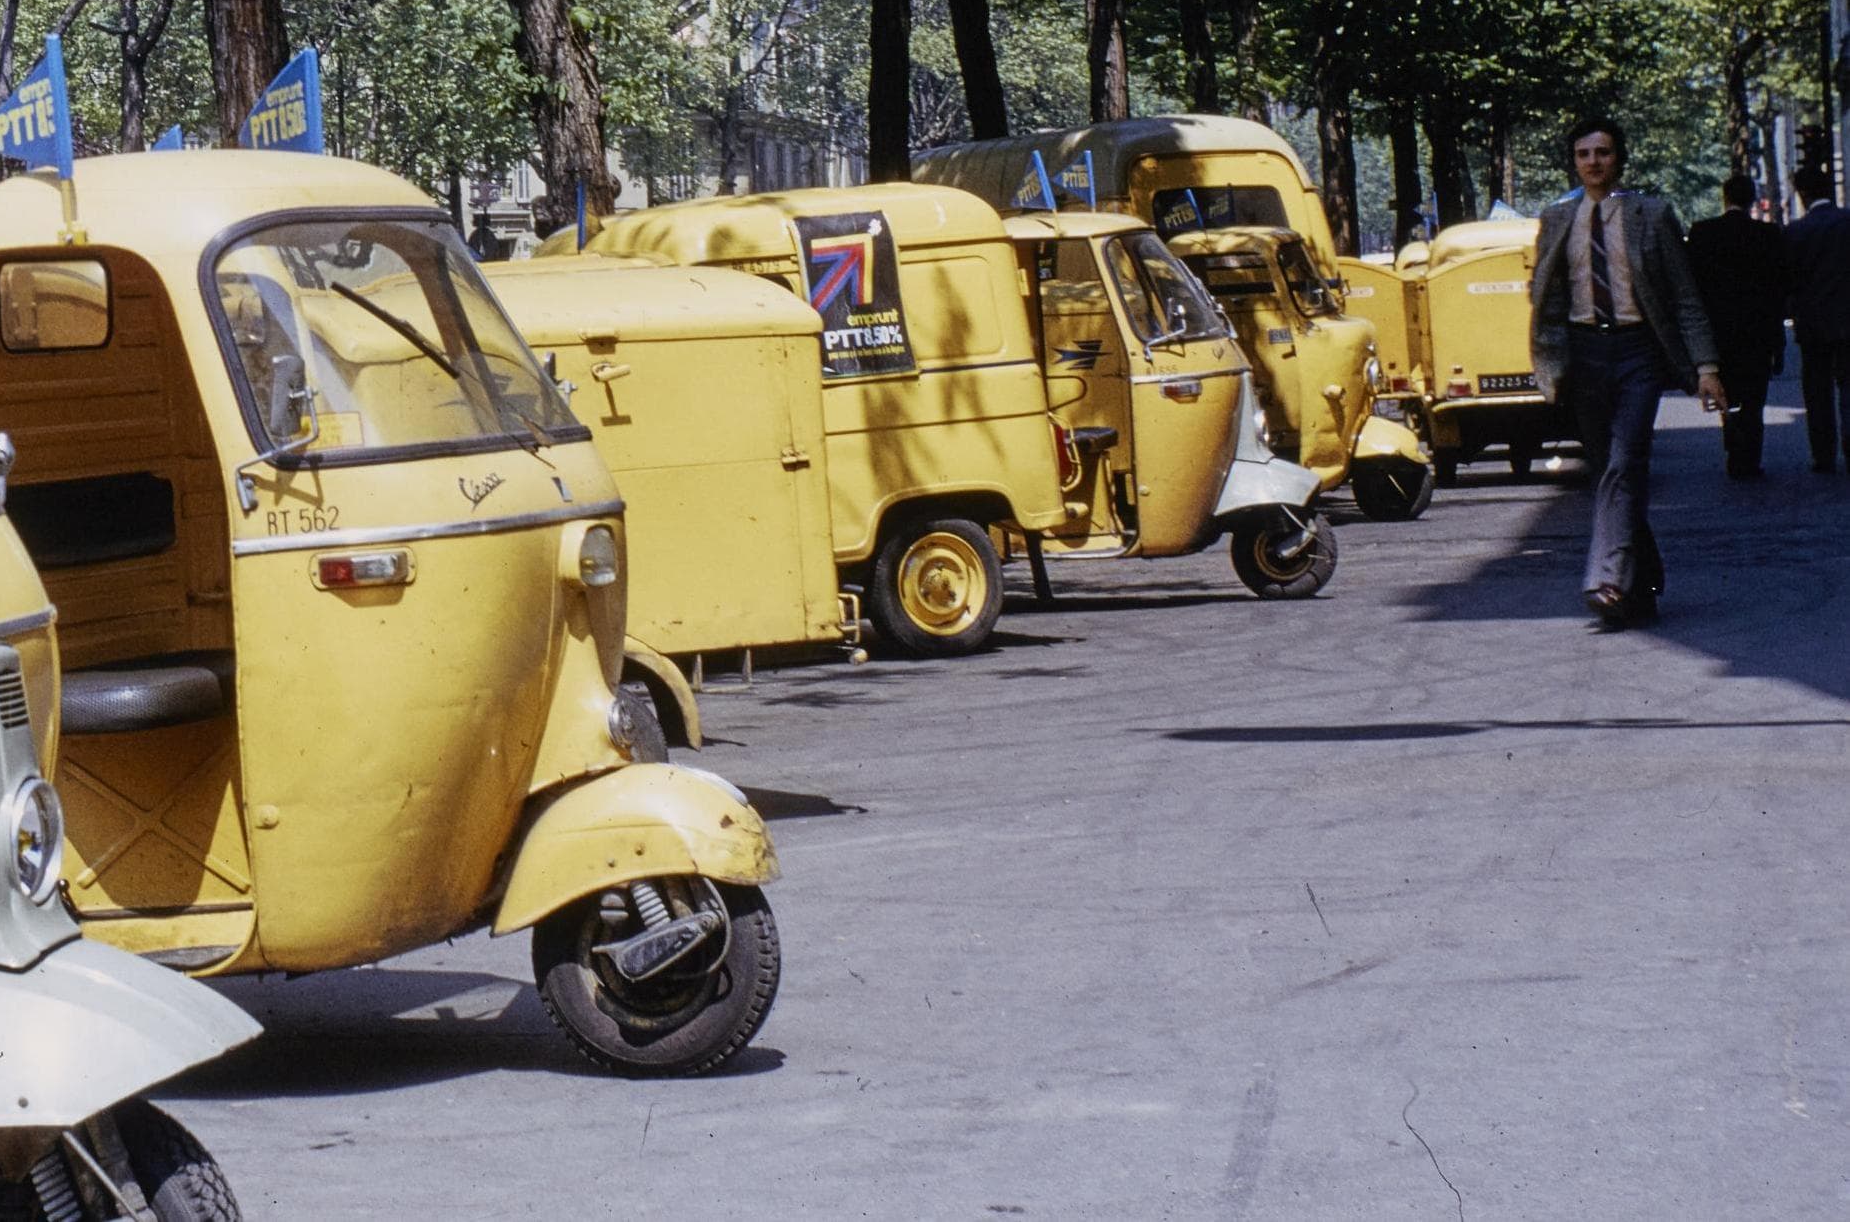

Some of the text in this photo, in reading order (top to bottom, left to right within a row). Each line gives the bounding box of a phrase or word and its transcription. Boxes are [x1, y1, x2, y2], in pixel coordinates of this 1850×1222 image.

[250, 107, 278, 150] PTT
[847, 308, 899, 327] emprunt
[823, 327, 863, 350] PTT
[266, 505, 341, 537] RT 562
